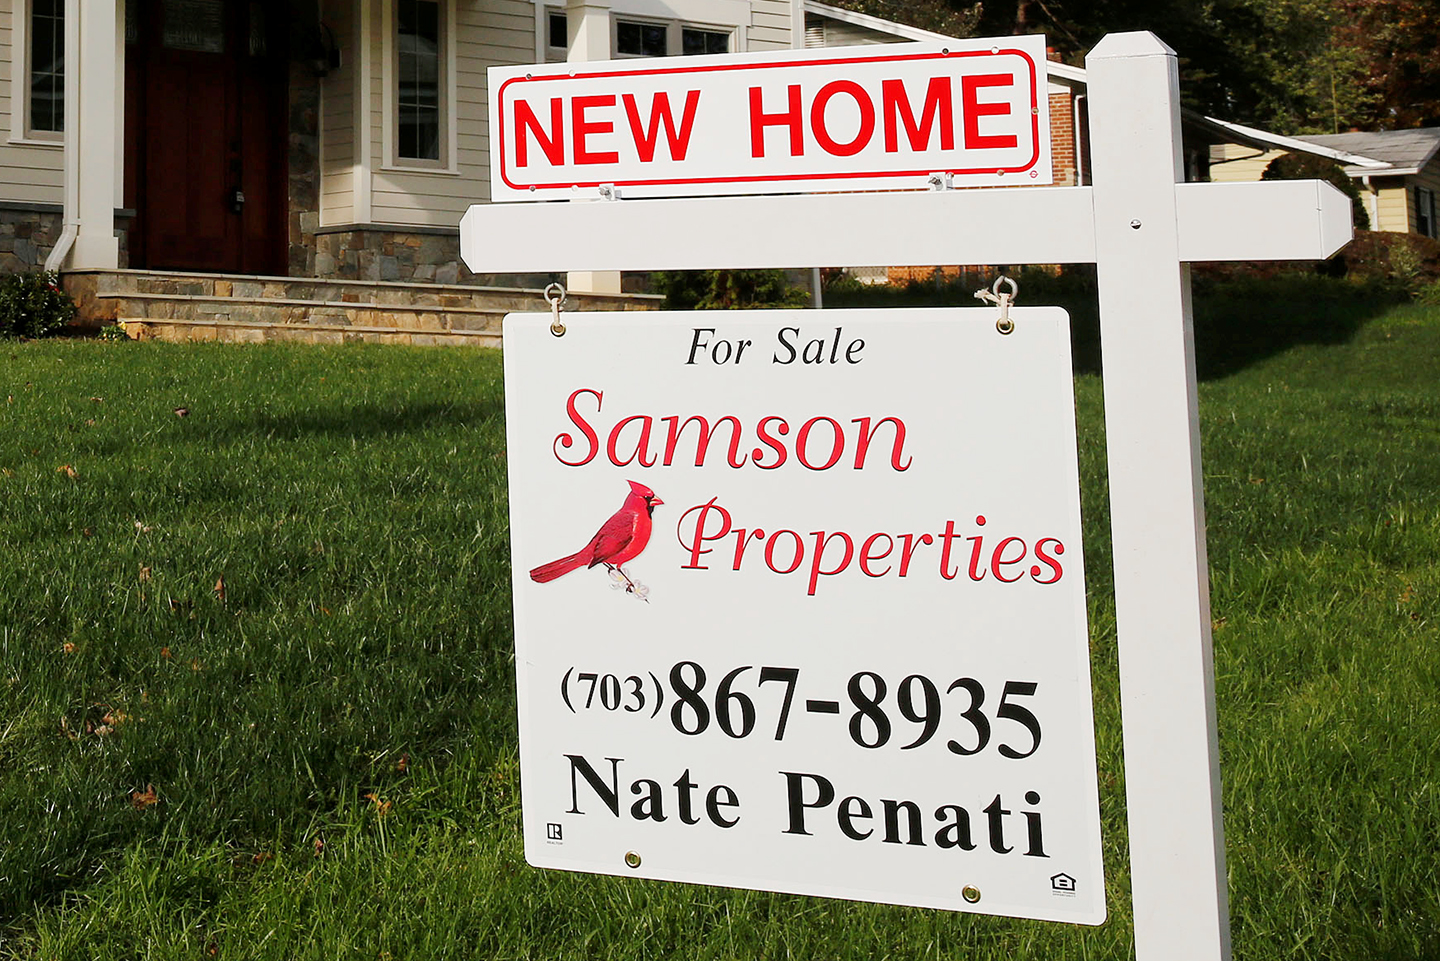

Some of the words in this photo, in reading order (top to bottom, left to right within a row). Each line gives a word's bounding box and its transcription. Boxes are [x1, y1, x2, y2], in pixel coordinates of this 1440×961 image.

[513, 89, 701, 168] NEW
[748, 72, 1018, 159] HOME
[684, 328, 752, 366] For
[772, 326, 866, 365] Sale
[552, 388, 913, 473] Samson
[676, 496, 1065, 597] Properties
[562, 754, 741, 829] Nate
[778, 771, 1051, 859] Penati
